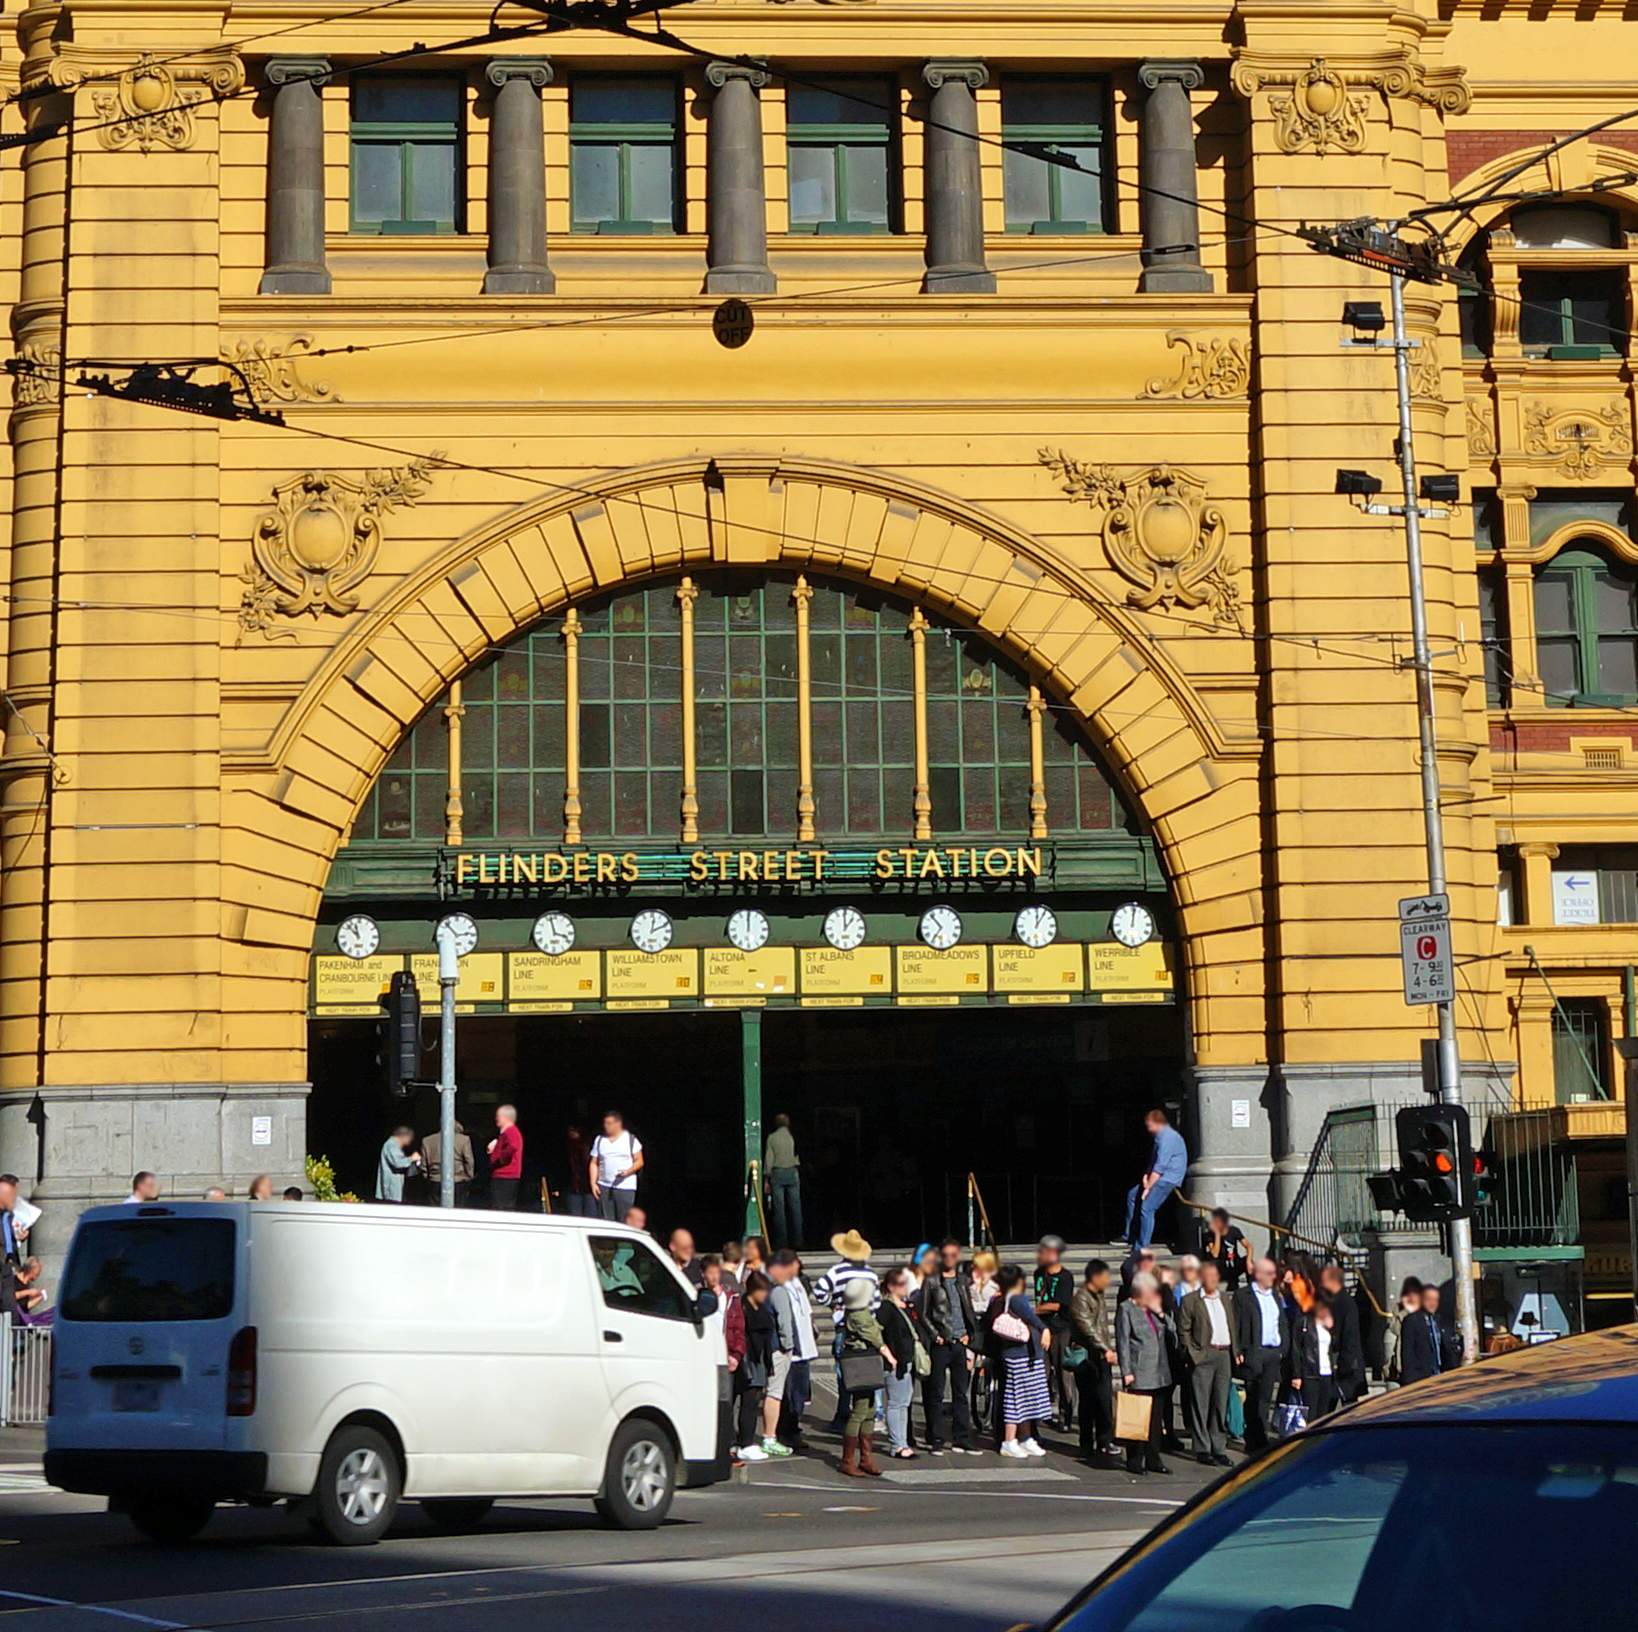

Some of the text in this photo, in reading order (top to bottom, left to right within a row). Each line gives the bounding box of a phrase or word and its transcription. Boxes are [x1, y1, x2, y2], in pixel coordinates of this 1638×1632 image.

[456, 847, 1042, 884] FLINDERS STREET STATION
[1403, 921, 1446, 936] CLEARWAY
[1420, 938, 1434, 957] C
[709, 952, 746, 963] ALTONA
[805, 951, 855, 961] ST ALBANS
[902, 949, 980, 960] BROADMEADOWS
[998, 949, 1036, 959] UPFIELD
[1094, 948, 1141, 958] WERRIBEE
[513, 956, 582, 967] SANDRINGHAM
[612, 954, 683, 964] WILLIAMSTOWN
[367, 960, 383, 970] and
[709, 965, 729, 975] LINE
[805, 965, 826, 975] LINE
[902, 963, 922, 974] LINE
[999, 962, 1019, 972] LINE
[1094, 961, 1115, 971] LINE
[513, 969, 534, 980] LINE
[612, 967, 632, 978] LINE
[319, 973, 376, 983] CRANBOURNE
